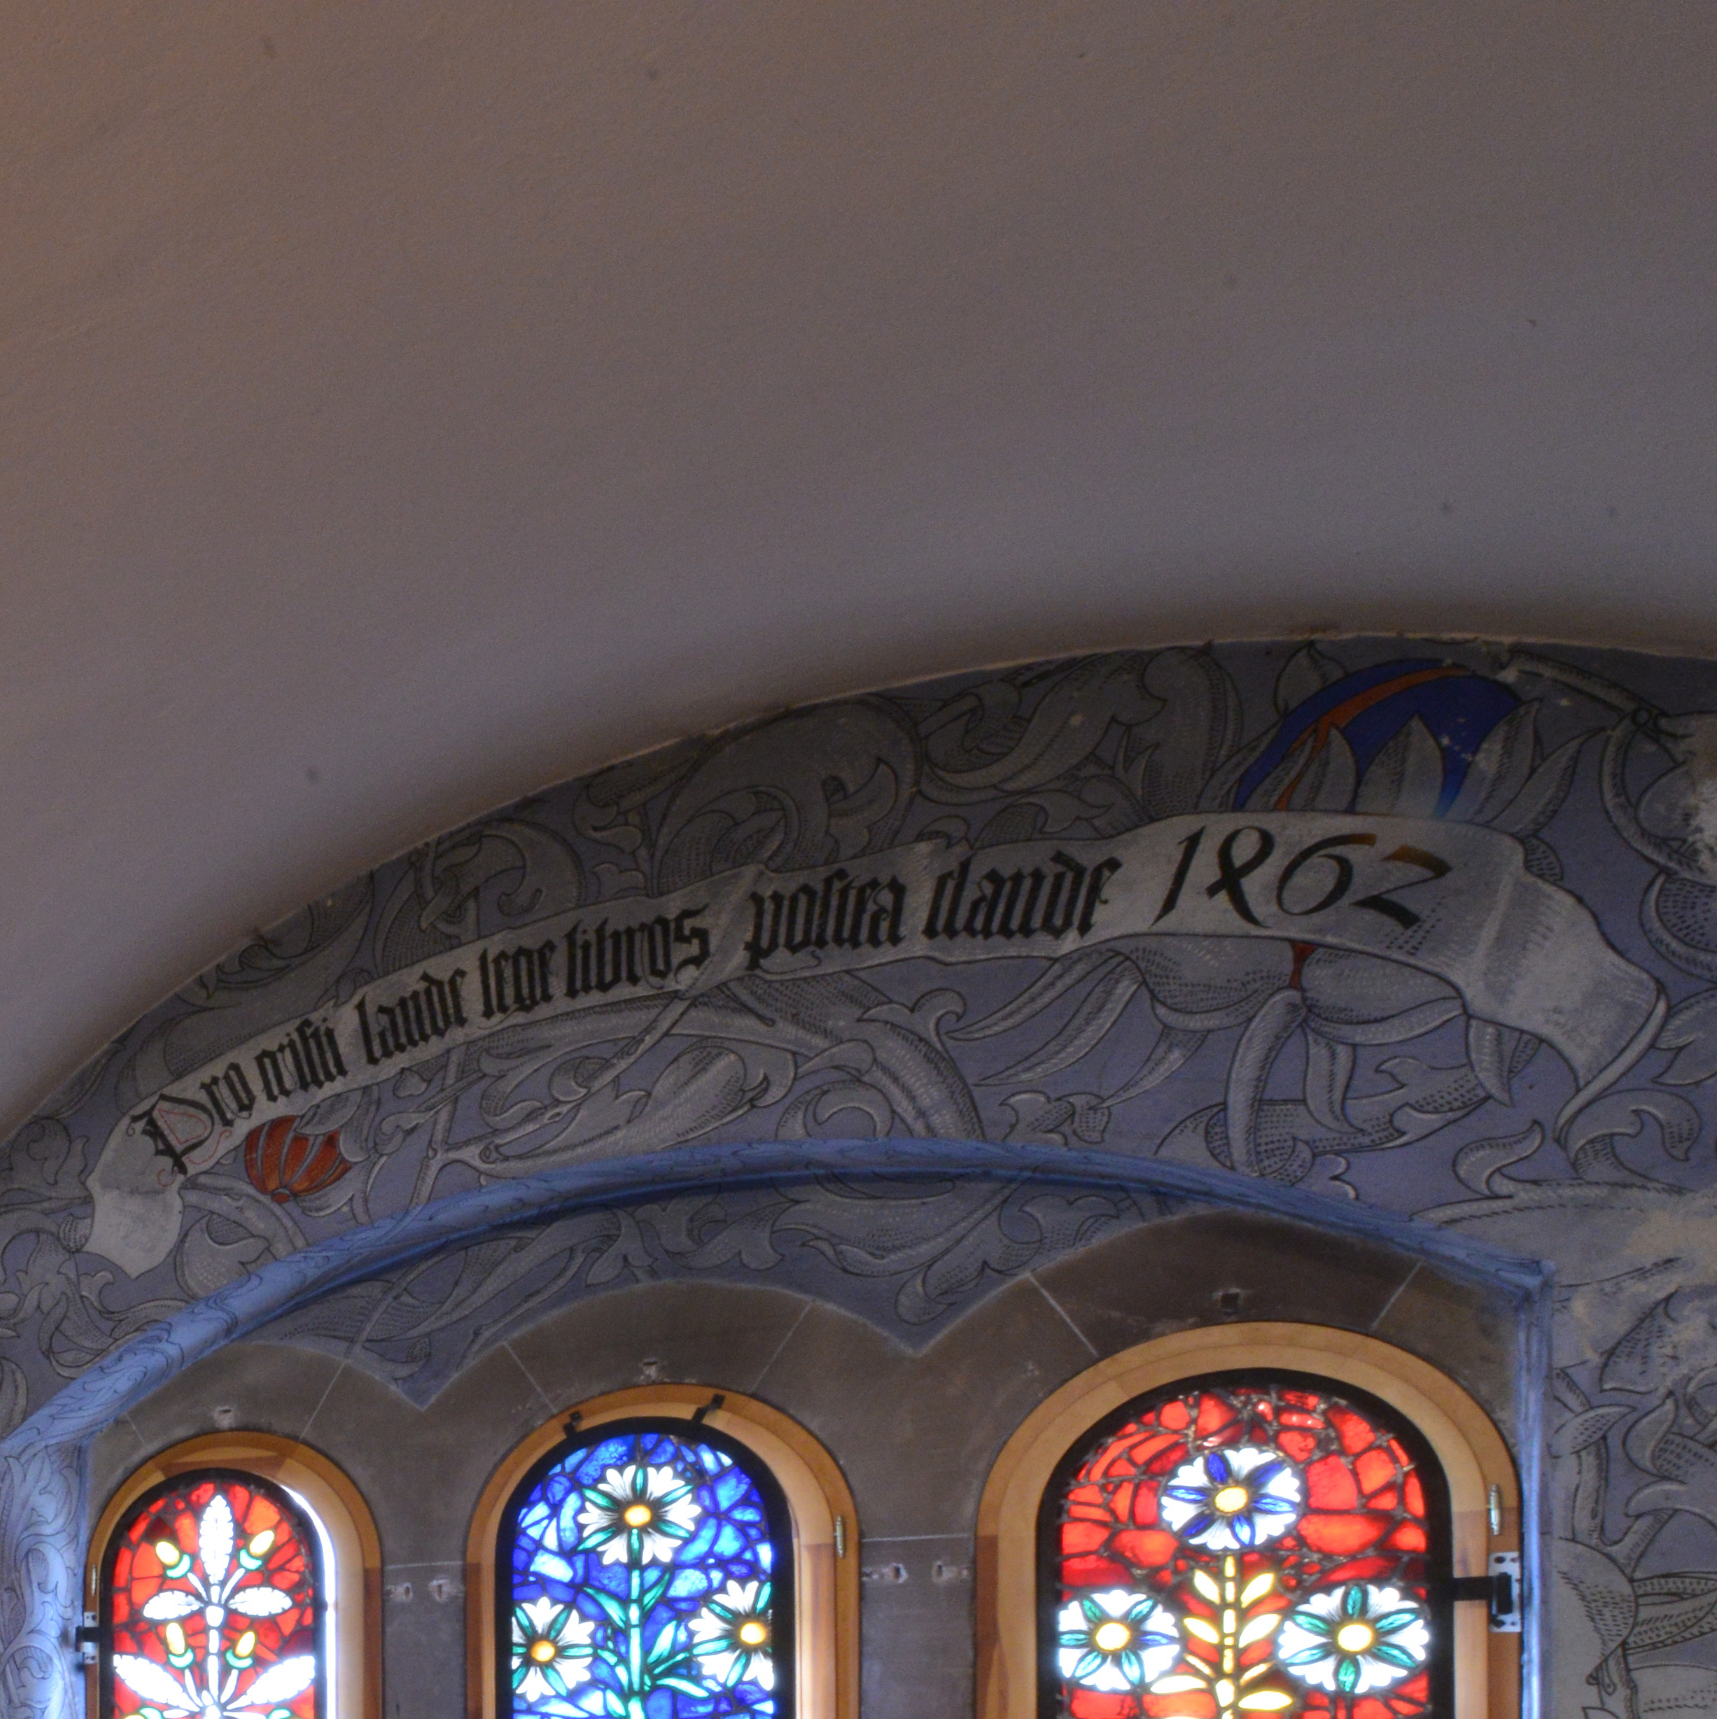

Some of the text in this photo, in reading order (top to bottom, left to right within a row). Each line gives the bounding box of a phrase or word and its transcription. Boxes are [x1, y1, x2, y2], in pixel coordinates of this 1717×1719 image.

[131, 1077, 255, 1179] Pro
[479, 938, 557, 1022] lege
[564, 905, 713, 1001] libros
[744, 867, 907, 971] postea
